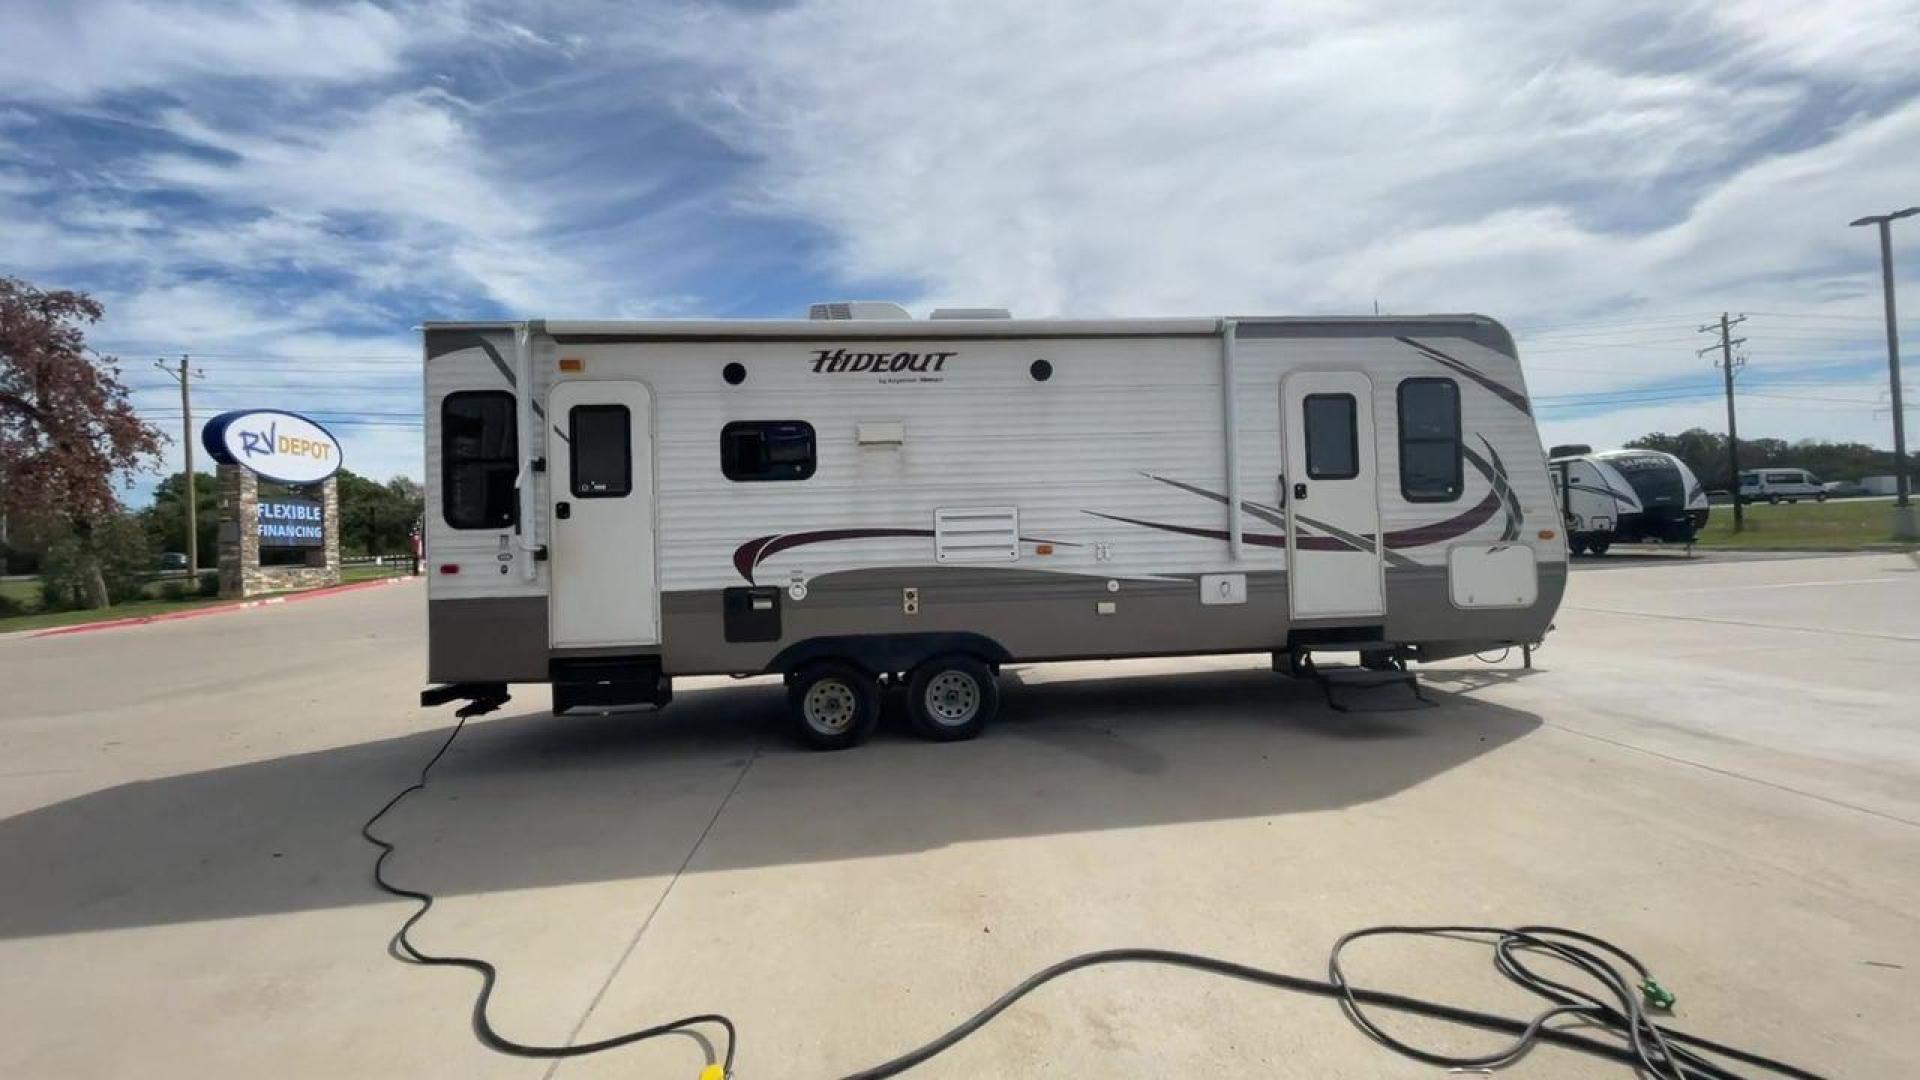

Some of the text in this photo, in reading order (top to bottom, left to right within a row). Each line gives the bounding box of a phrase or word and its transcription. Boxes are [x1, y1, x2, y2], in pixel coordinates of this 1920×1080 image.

[808, 348, 958, 373] HIDEOUT
[239, 421, 330, 459] RV DEPOT
[257, 503, 321, 520] FLEXIBLE
[257, 525, 322, 538] FINANCING
